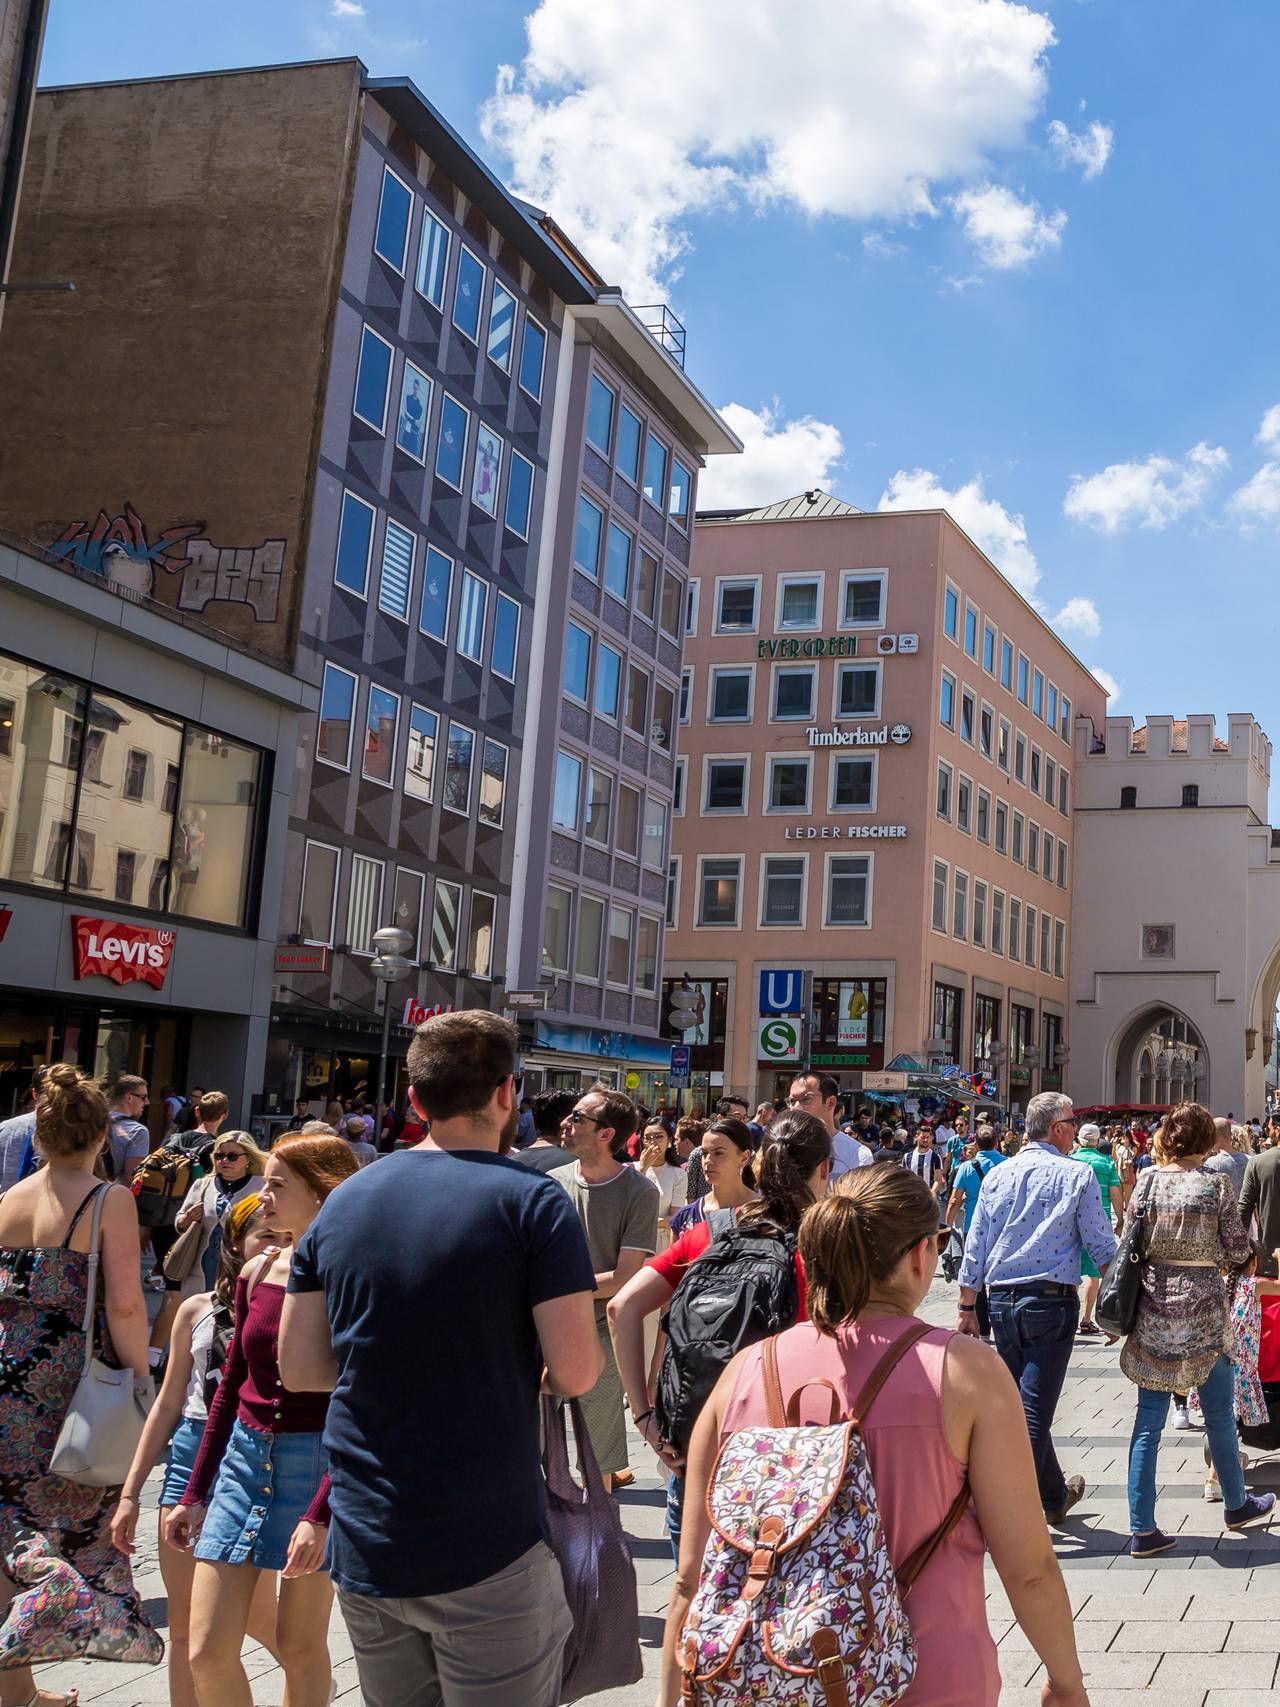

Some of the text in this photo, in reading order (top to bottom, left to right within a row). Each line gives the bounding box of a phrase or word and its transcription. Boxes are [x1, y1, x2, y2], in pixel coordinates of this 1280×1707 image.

[757, 635, 858, 659] EVERGREEN
[806, 724, 888, 746] Timberland
[784, 825, 907, 839] LEDER FISCHER
[767, 972, 794, 1009] U
[767, 1024, 790, 1054] S
[672, 1067, 687, 1076] TAXI
